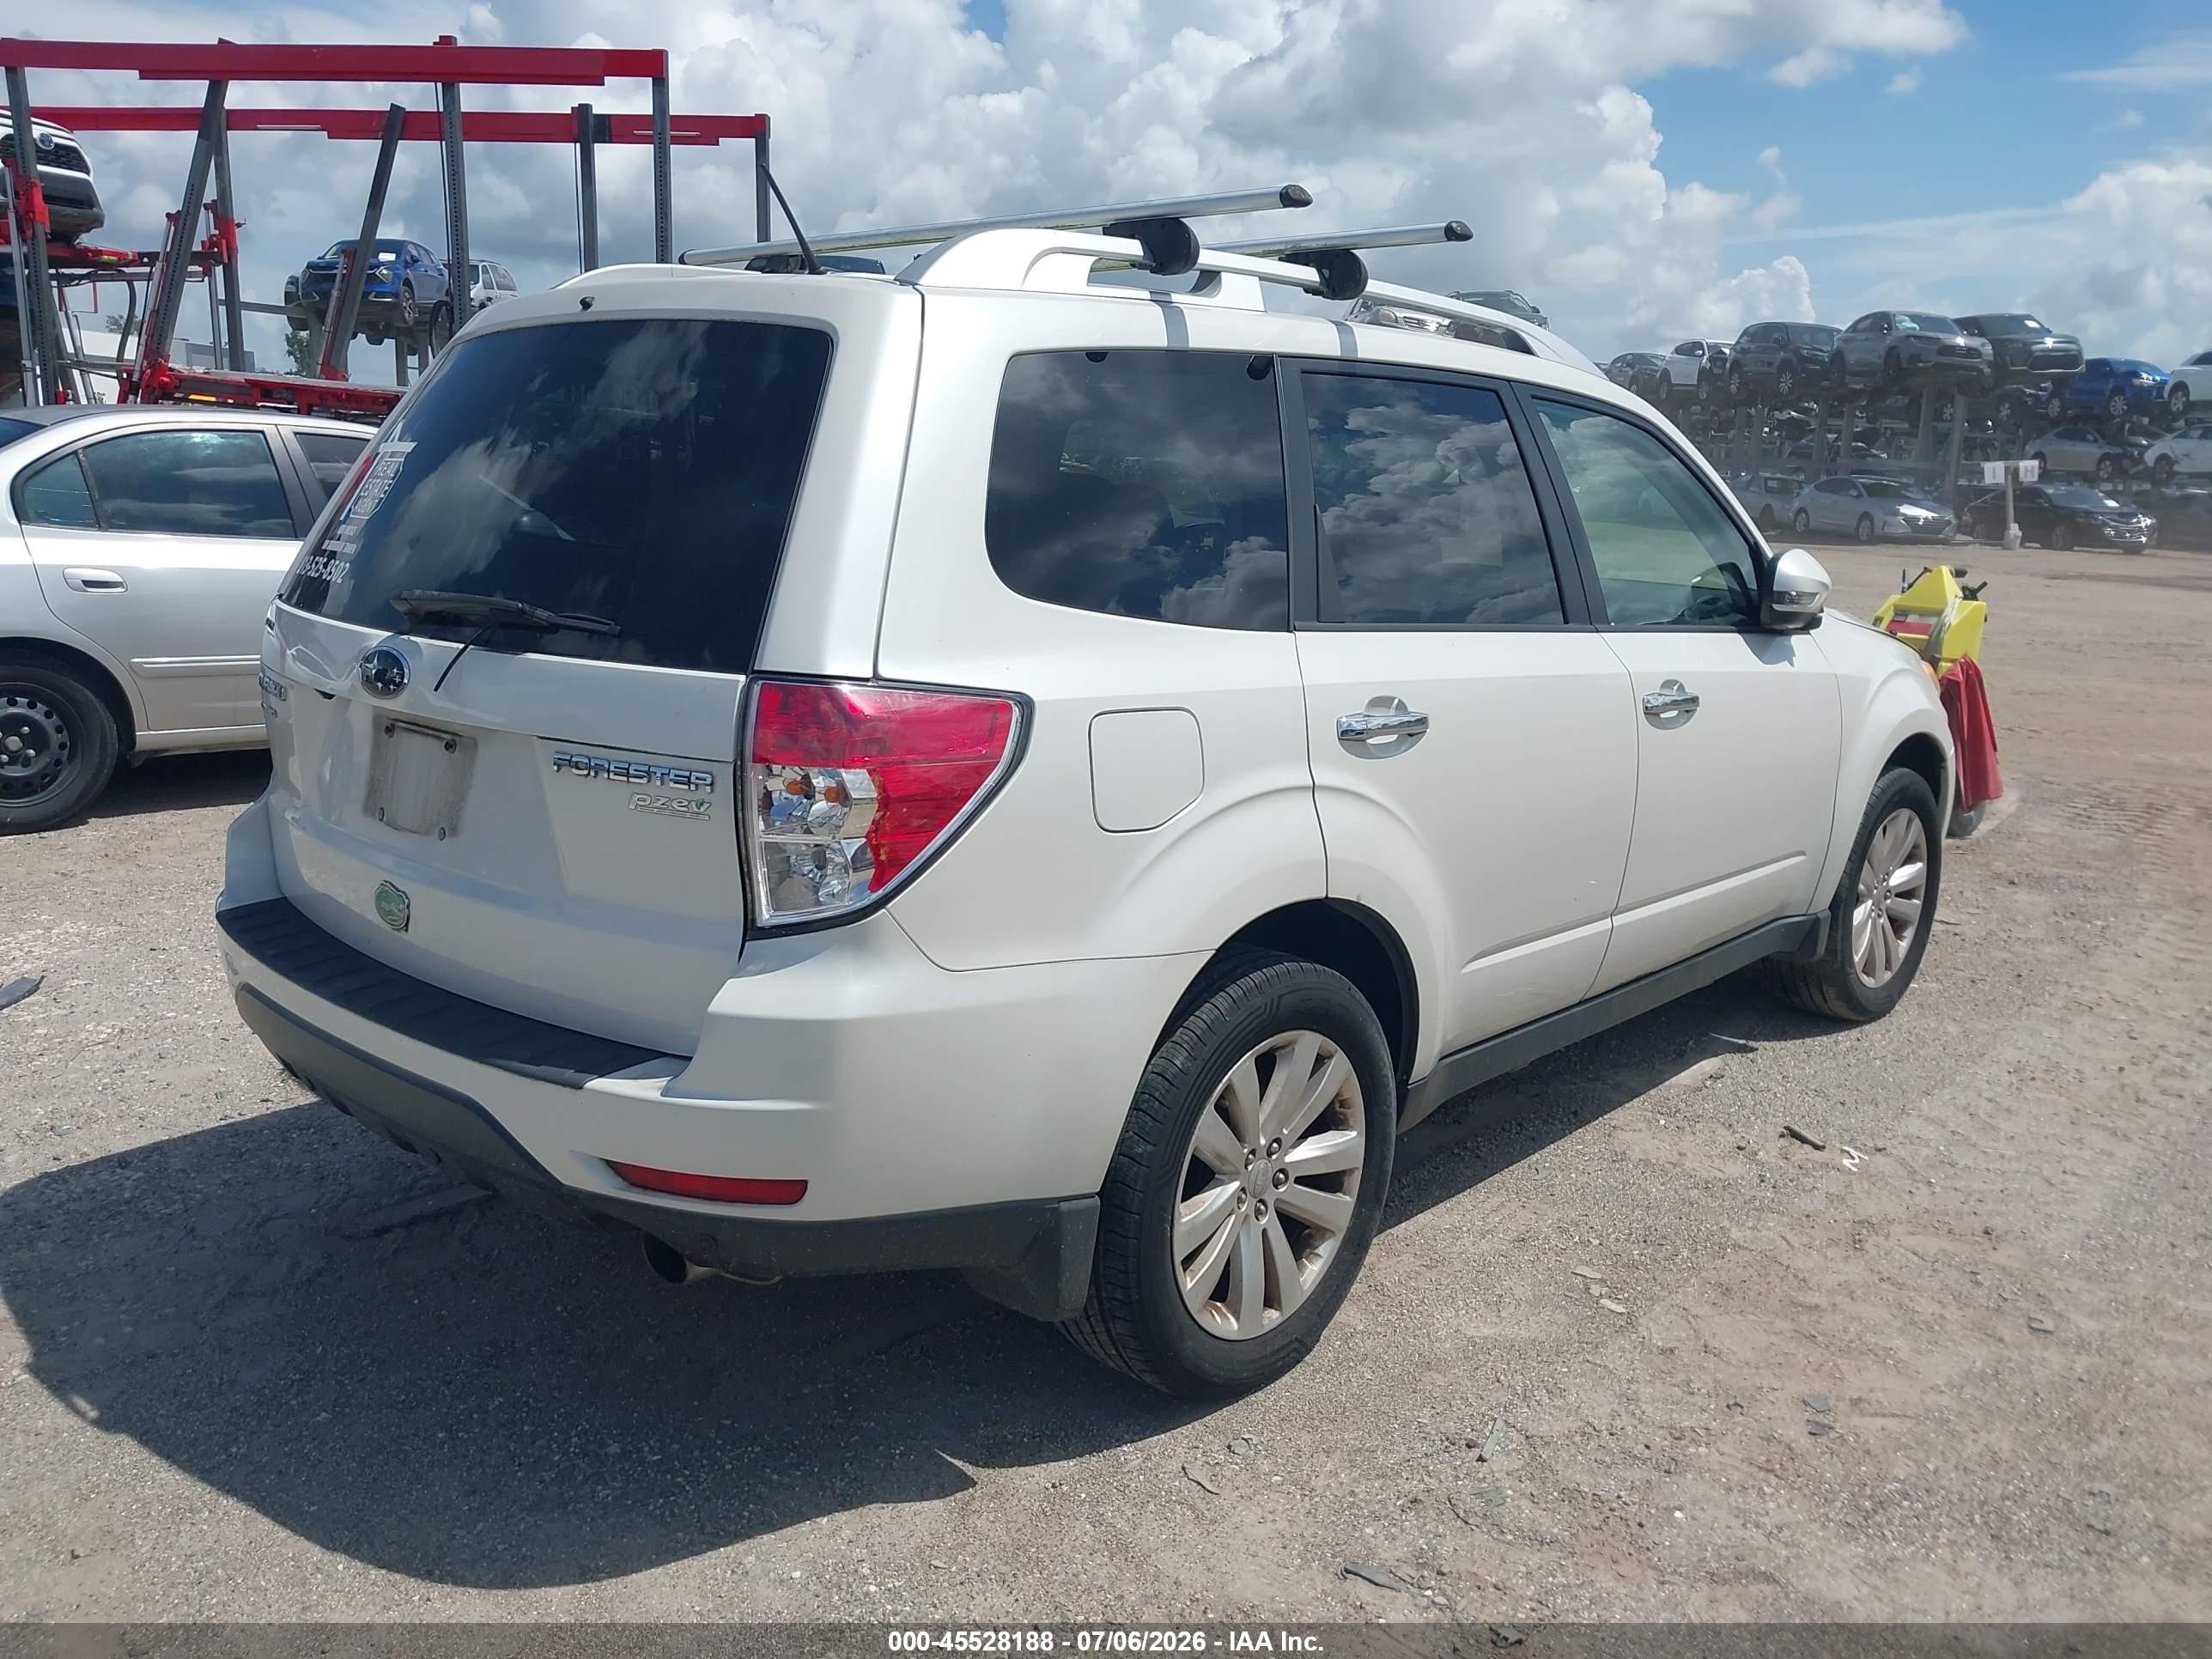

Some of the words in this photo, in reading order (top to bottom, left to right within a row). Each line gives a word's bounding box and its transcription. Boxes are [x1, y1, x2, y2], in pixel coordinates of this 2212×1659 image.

[375, 461, 401, 477] REAL
[2024, 465, 2034, 479] H
[360, 478, 393, 498] ESTATE
[553, 751, 714, 793] FORESTER
